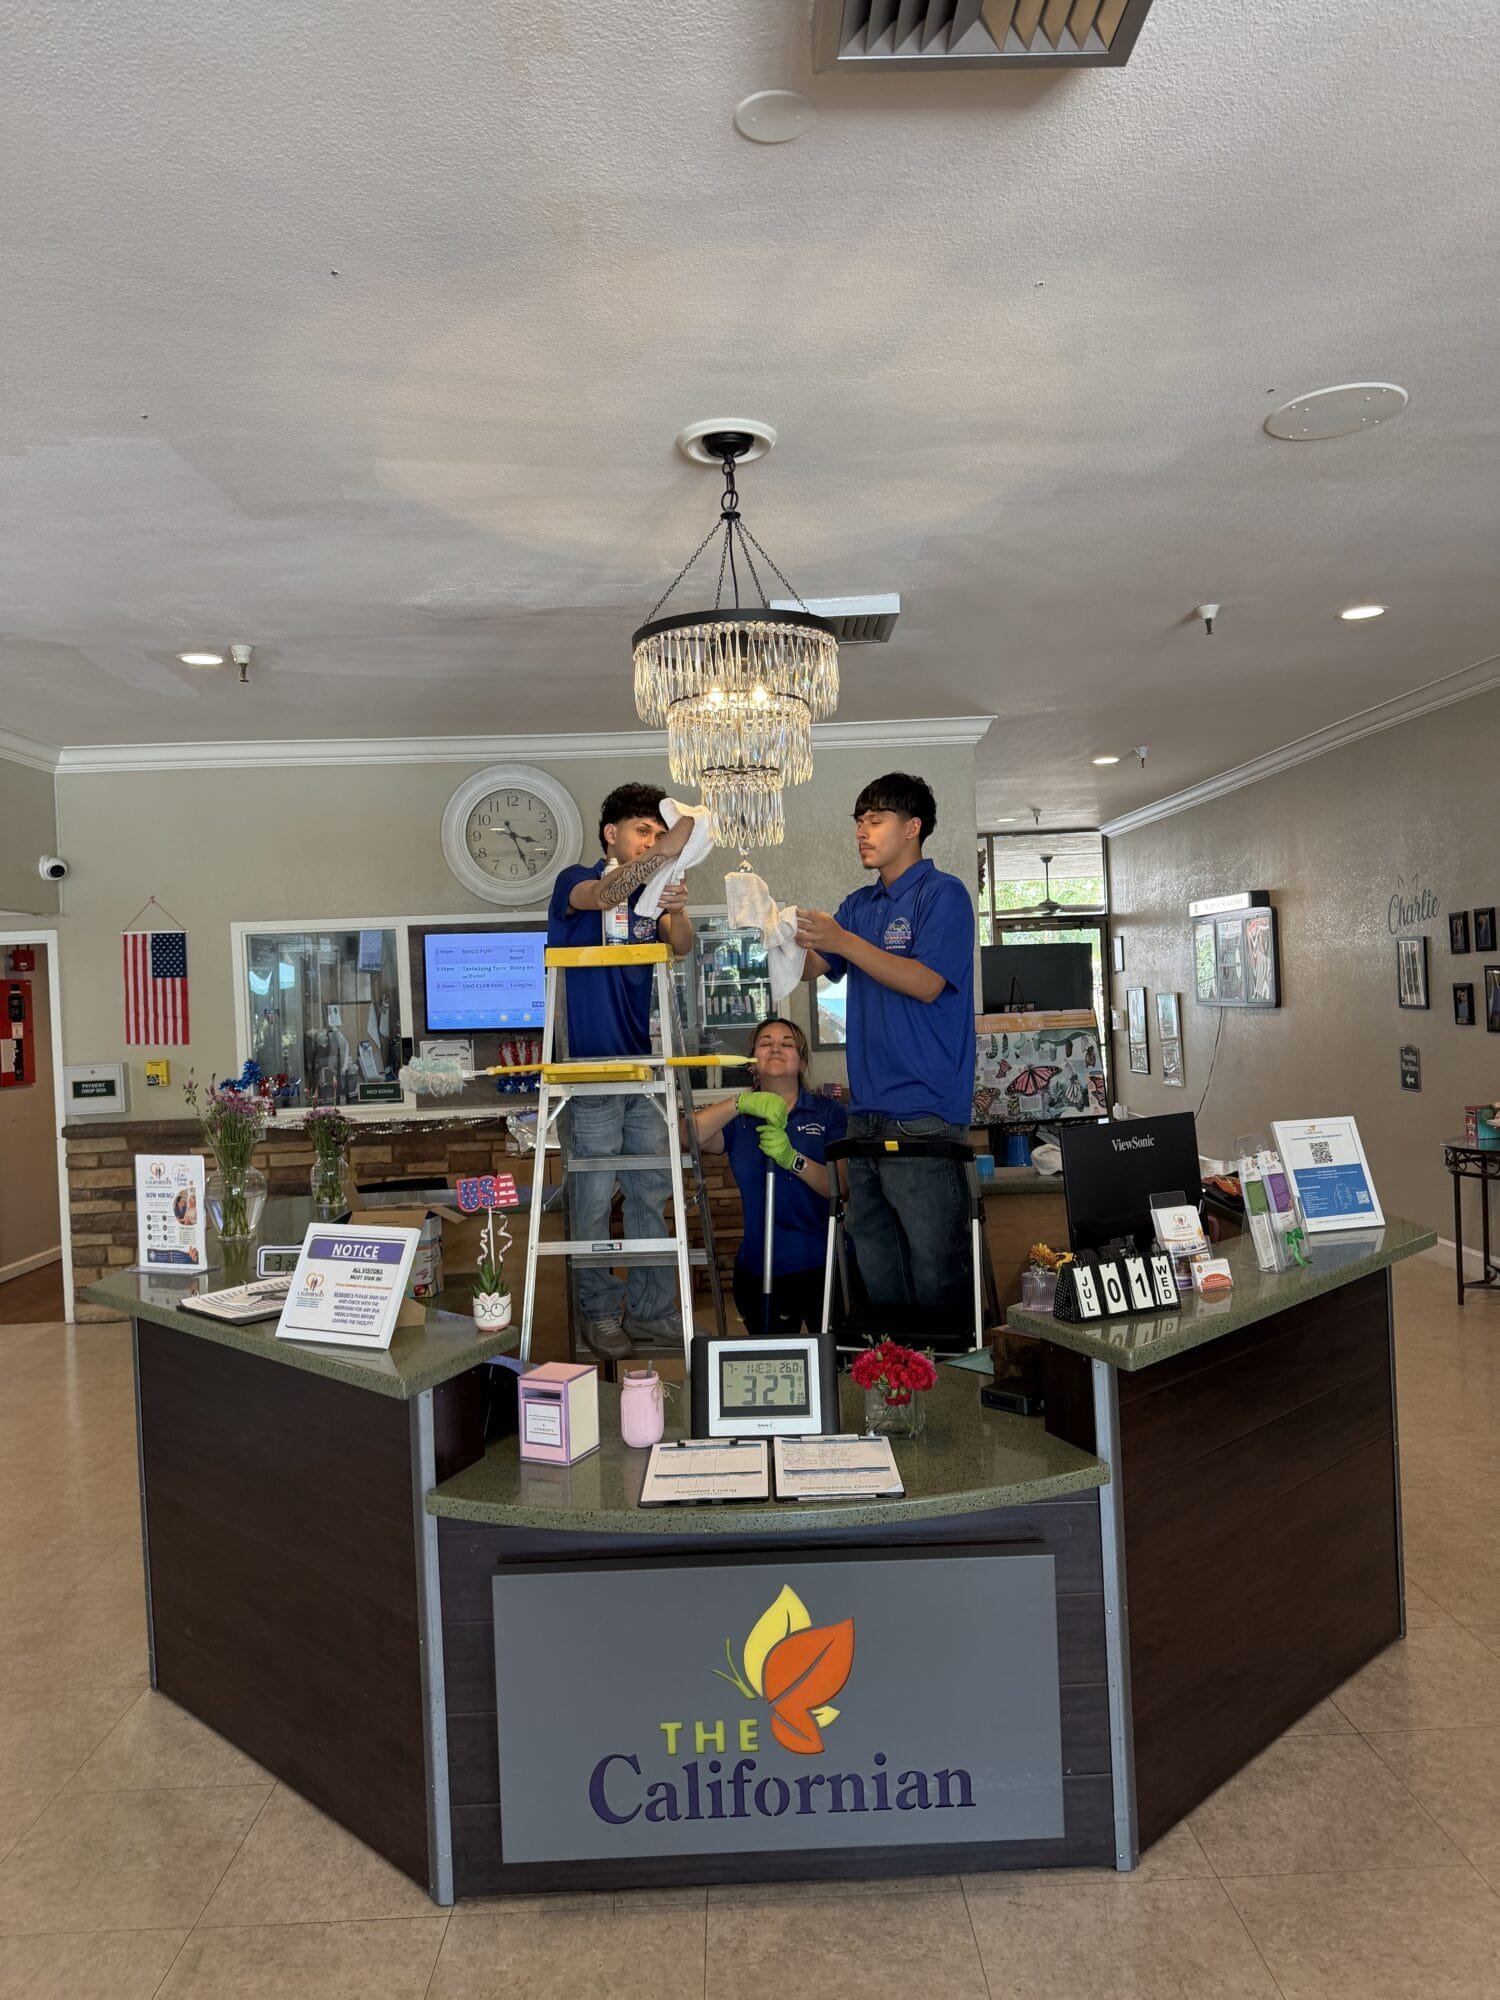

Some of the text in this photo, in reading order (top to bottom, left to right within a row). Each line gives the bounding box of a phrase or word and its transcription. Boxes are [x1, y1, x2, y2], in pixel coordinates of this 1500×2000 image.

[489, 801, 500, 812] 11
[506, 795, 519, 806] 12
[528, 800, 532, 810] 1
[478, 814, 491, 826] 10
[538, 812, 548, 823] 2
[472, 832, 482, 842] 9
[544, 828, 553, 840] 3
[478, 848, 487, 858] 8
[492, 860, 500, 870] 7
[510, 864, 519, 875] 6
[528, 859, 536, 871] 5
[1388, 889, 1440, 935] Charlie
[1111, 1134, 1156, 1152] ViewSonic
[332, 1243, 380, 1258] NOTICE
[1082, 1276, 1096, 1312] JUL
[1156, 1264, 1172, 1300] WED
[660, 1719, 760, 1755] THE
[588, 1752, 976, 1825] Californian
